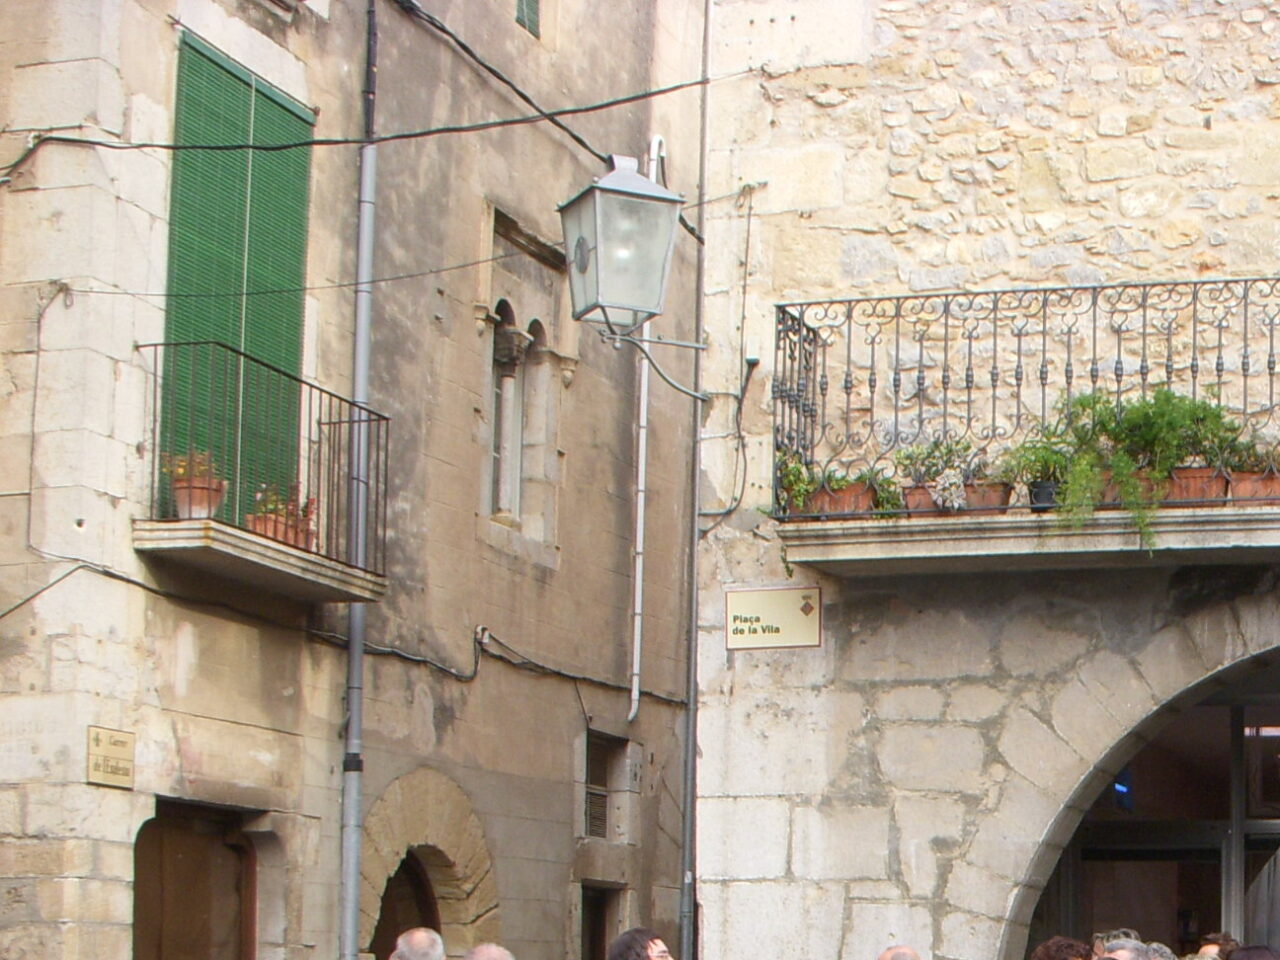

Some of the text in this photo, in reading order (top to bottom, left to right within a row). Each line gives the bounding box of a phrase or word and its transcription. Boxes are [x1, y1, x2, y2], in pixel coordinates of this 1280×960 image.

[733, 615, 761, 625] Plaça
[732, 624, 780, 635] de la Vila
